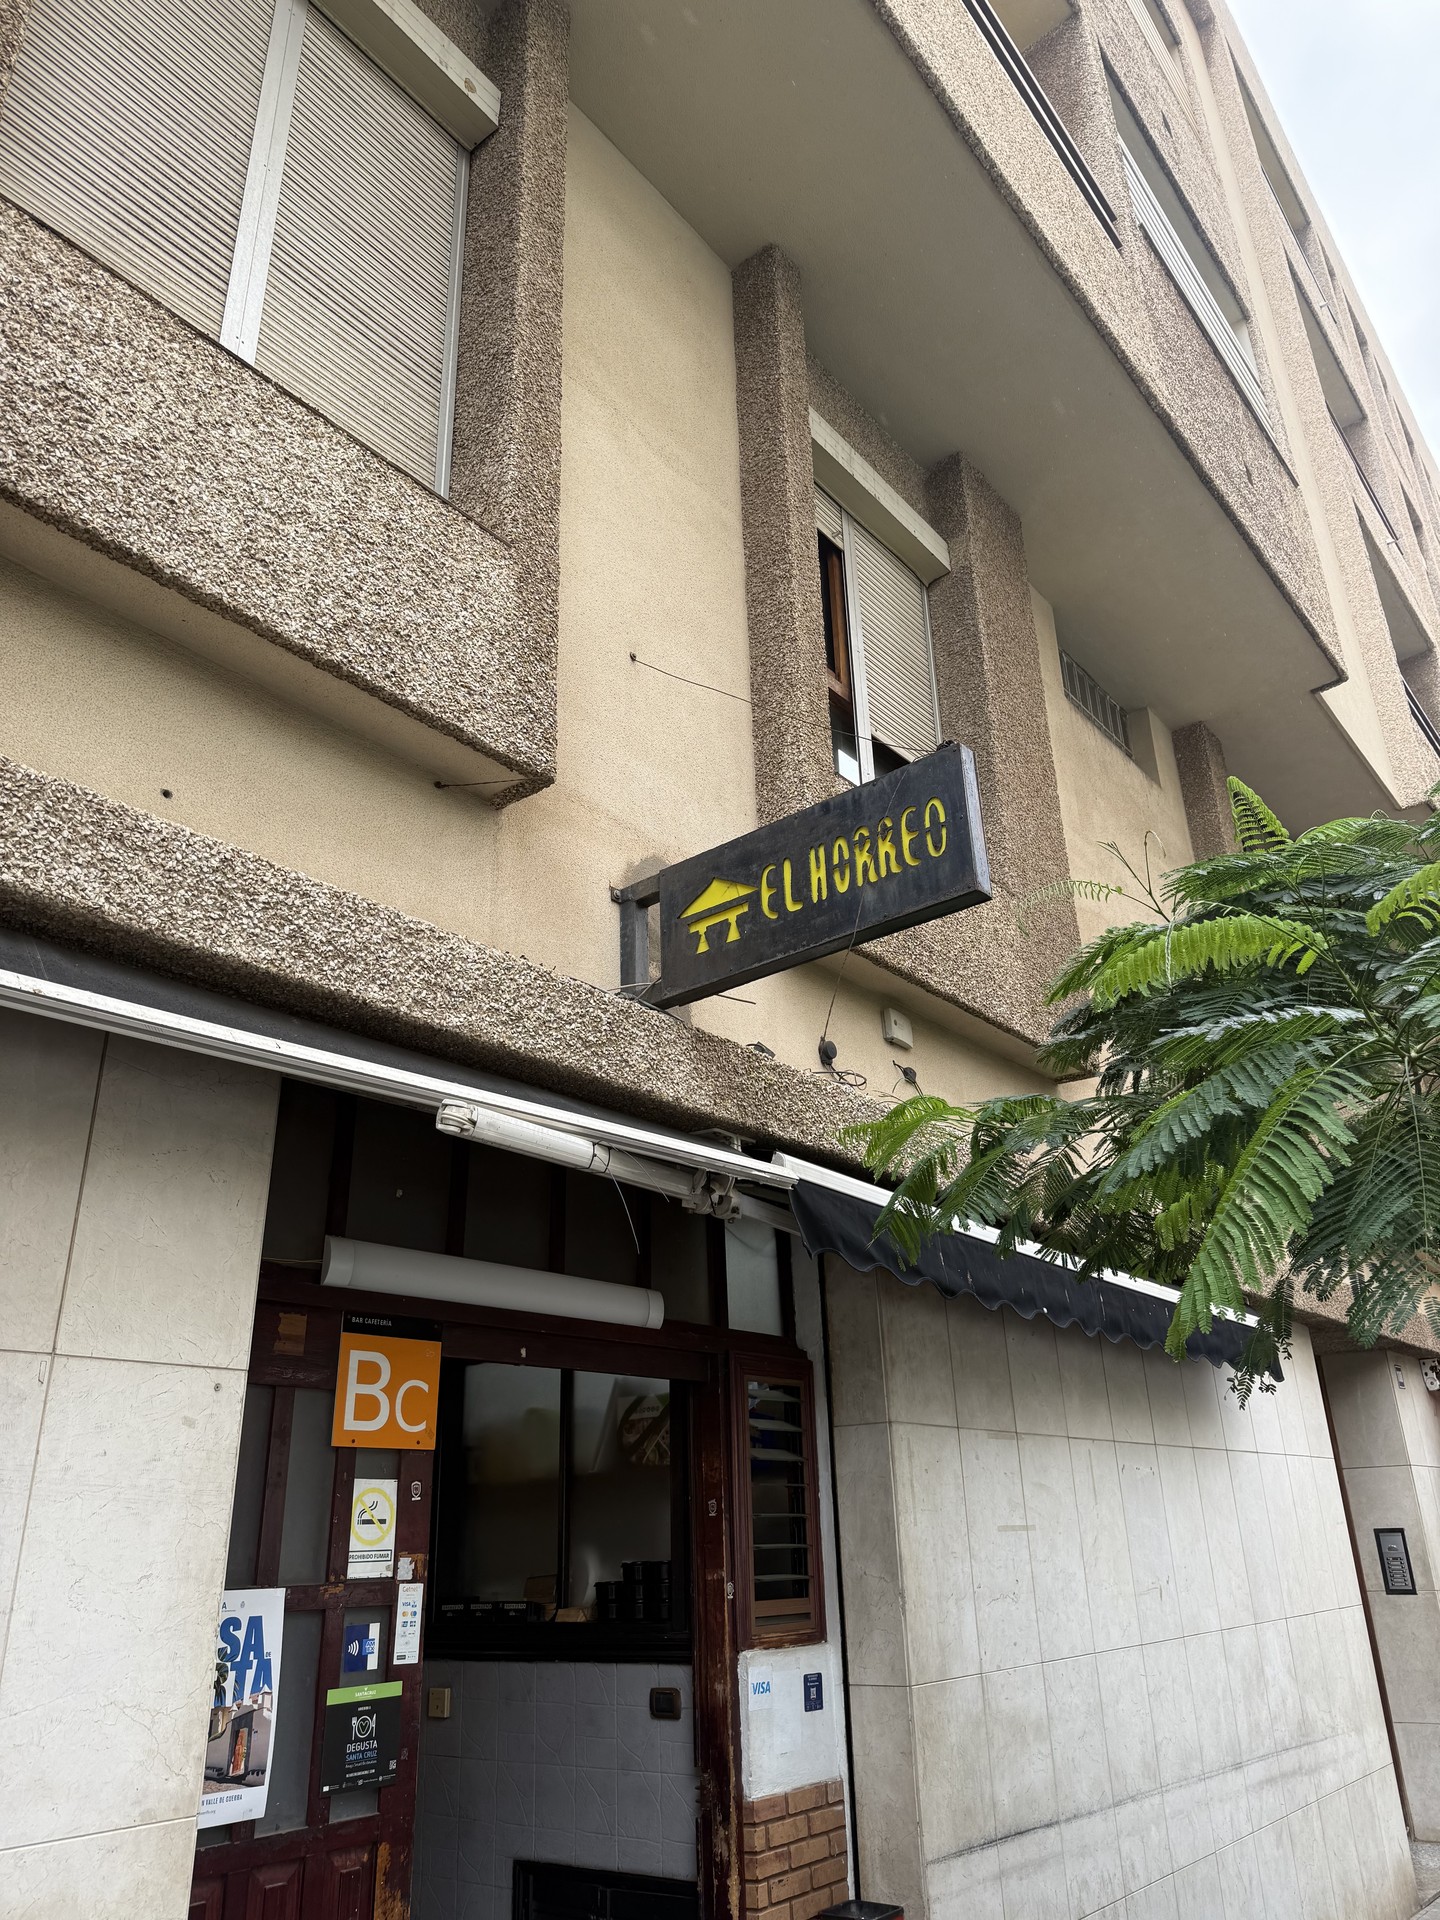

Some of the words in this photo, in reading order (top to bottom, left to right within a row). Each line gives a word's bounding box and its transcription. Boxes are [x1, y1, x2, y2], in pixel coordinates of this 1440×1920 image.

[761, 858, 803, 920] EL
[809, 797, 947, 904] HORREO
[351, 1316, 363, 1324] BAR
[349, 1553, 374, 1561] PROHIBIDO
[751, 1681, 771, 1695] VISA
[346, 1740, 378, 1753] DEGUSTA
[345, 1753, 363, 1761] SANTA
[363, 1750, 378, 1759] CRUZ
[205, 1797, 218, 1806] VALLE
[218, 1796, 225, 1804] DE
[225, 1794, 243, 1803] GUERRA
